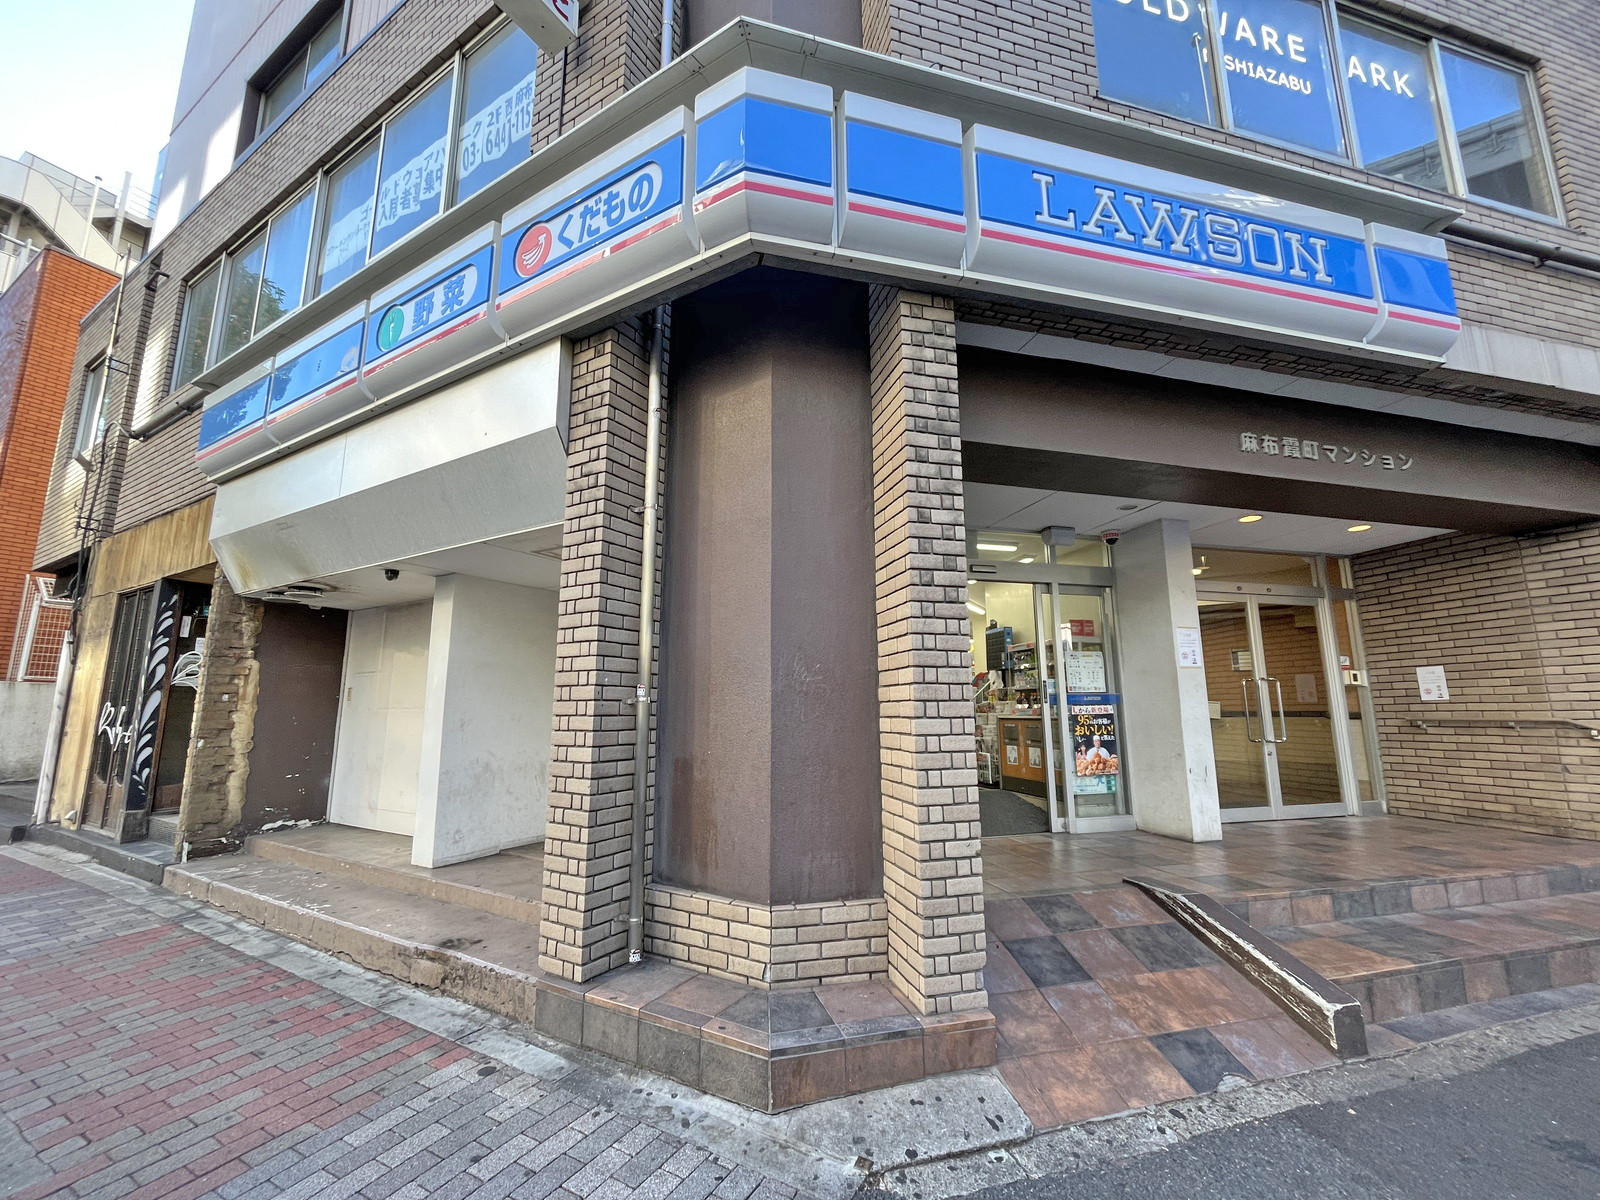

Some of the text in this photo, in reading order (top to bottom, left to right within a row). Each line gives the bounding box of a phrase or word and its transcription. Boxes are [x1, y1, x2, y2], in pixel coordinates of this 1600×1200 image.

[487, 105, 503, 128] 2F
[557, 171, 655, 250] くだもの
[1031, 171, 1334, 286] LAWSON
[411, 272, 467, 332] 野菜
[1239, 431, 1413, 471] 麻布霞町マンション
